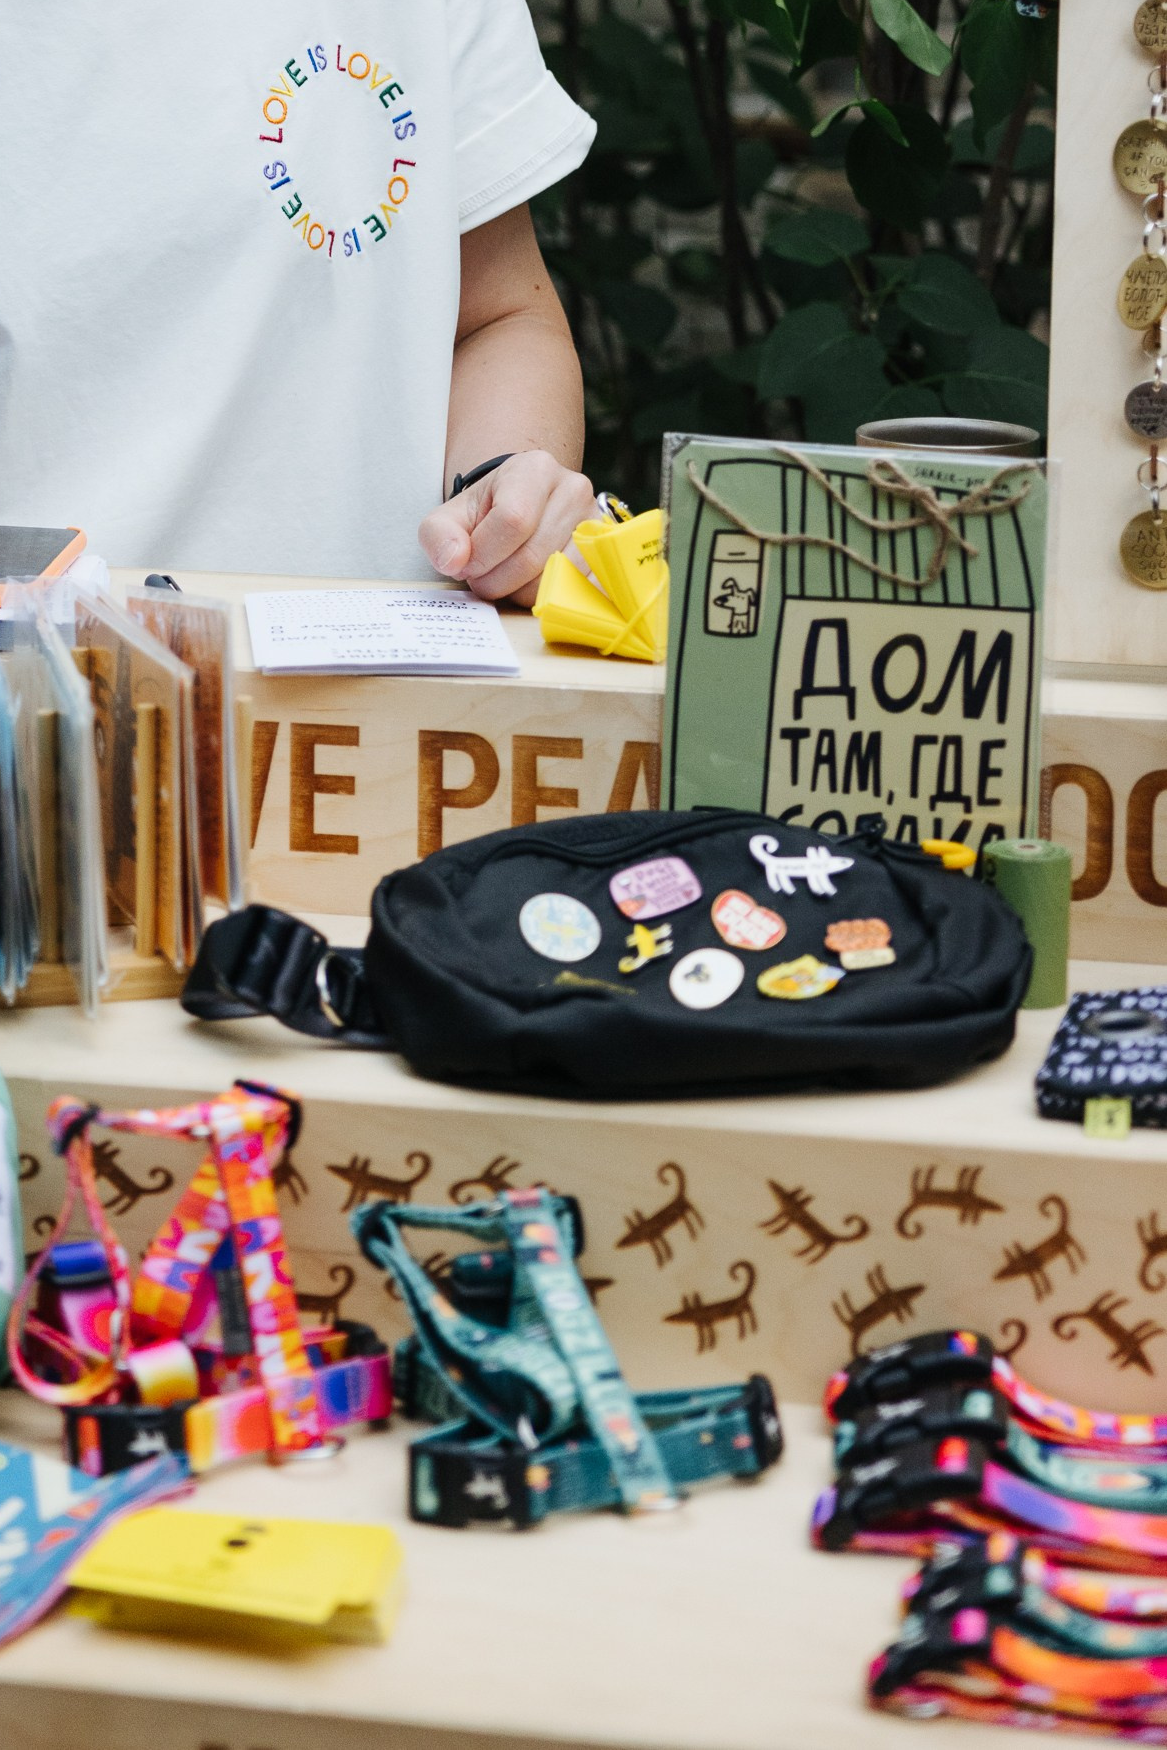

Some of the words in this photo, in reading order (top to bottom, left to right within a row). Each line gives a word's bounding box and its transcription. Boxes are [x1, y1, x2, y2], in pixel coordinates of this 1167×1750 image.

[307, 44, 327, 73] IS
[336, 44, 405, 109] LOVE
[259, 58, 308, 144] LOVE
[392, 110, 417, 141] IS
[263, 160, 294, 191] IS
[362, 157, 417, 243] LOVE
[280, 192, 336, 258] LOVE
[342, 227, 362, 257] IS
[793, 618, 1014, 725] ДОМ
[780, 727, 895, 806] ТАМ,
[909, 734, 1007, 814] ГДЕ
